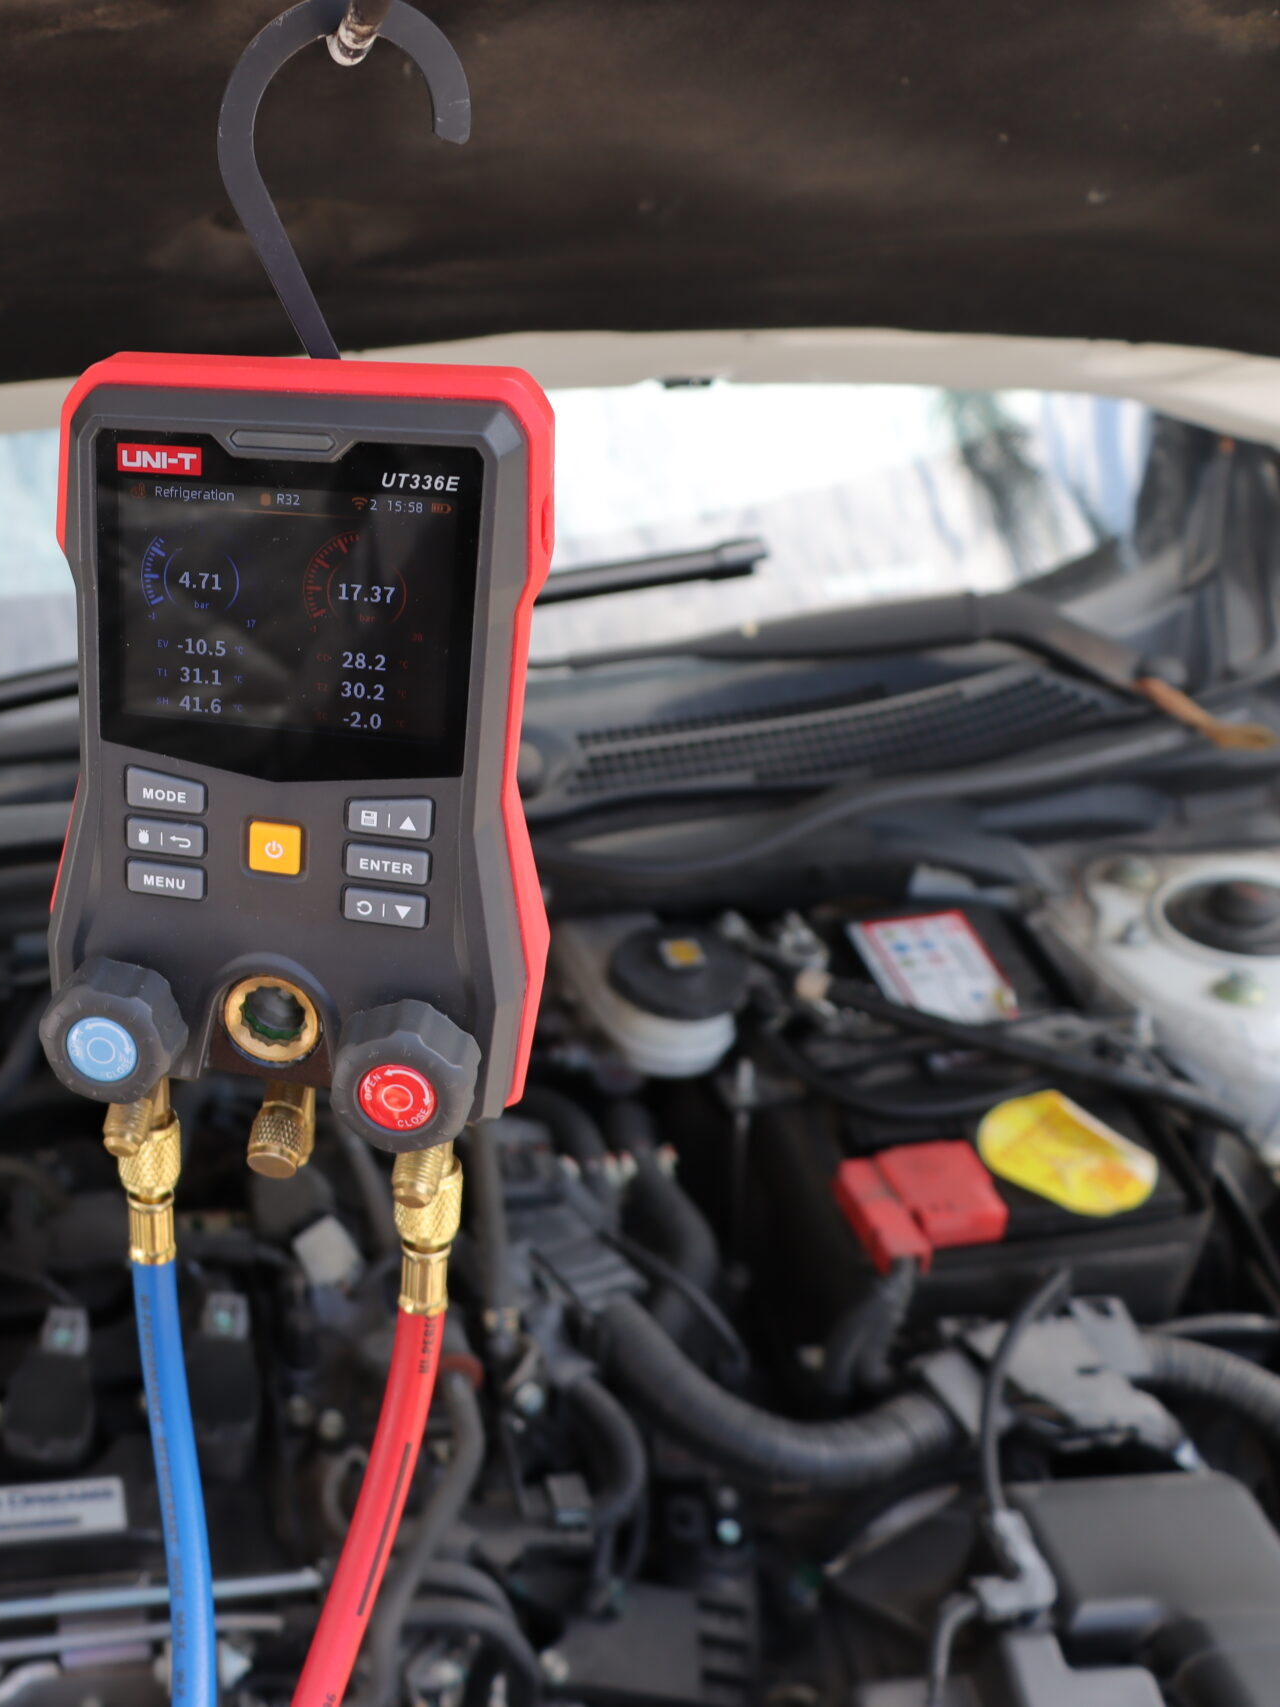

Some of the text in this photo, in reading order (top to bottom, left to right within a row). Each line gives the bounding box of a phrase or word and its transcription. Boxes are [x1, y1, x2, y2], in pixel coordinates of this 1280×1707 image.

[121, 449, 197, 471] UNI-T
[381, 472, 460, 492] UT336E
[154, 485, 235, 502] Refrigeration
[276, 493, 301, 506] R32
[369, 500, 424, 513] 2 15:58
[178, 570, 222, 591] 4.71
[337, 582, 396, 605] 17.37
[193, 600, 210, 609] bar
[358, 613, 377, 623] bar
[157, 639, 169, 649] EV
[177, 637, 227, 657] -10.5
[341, 650, 387, 672] 28.2
[179, 665, 222, 686] 31.1
[340, 680, 385, 701] 30.2
[179, 694, 223, 714] 41.6
[342, 711, 383, 730] -2.0
[142, 787, 186, 804] MODE
[359, 857, 413, 876] ENTER
[143, 873, 186, 890] MENU
[364, 1072, 383, 1101] OPEN
[397, 1107, 430, 1128] CLOSE
